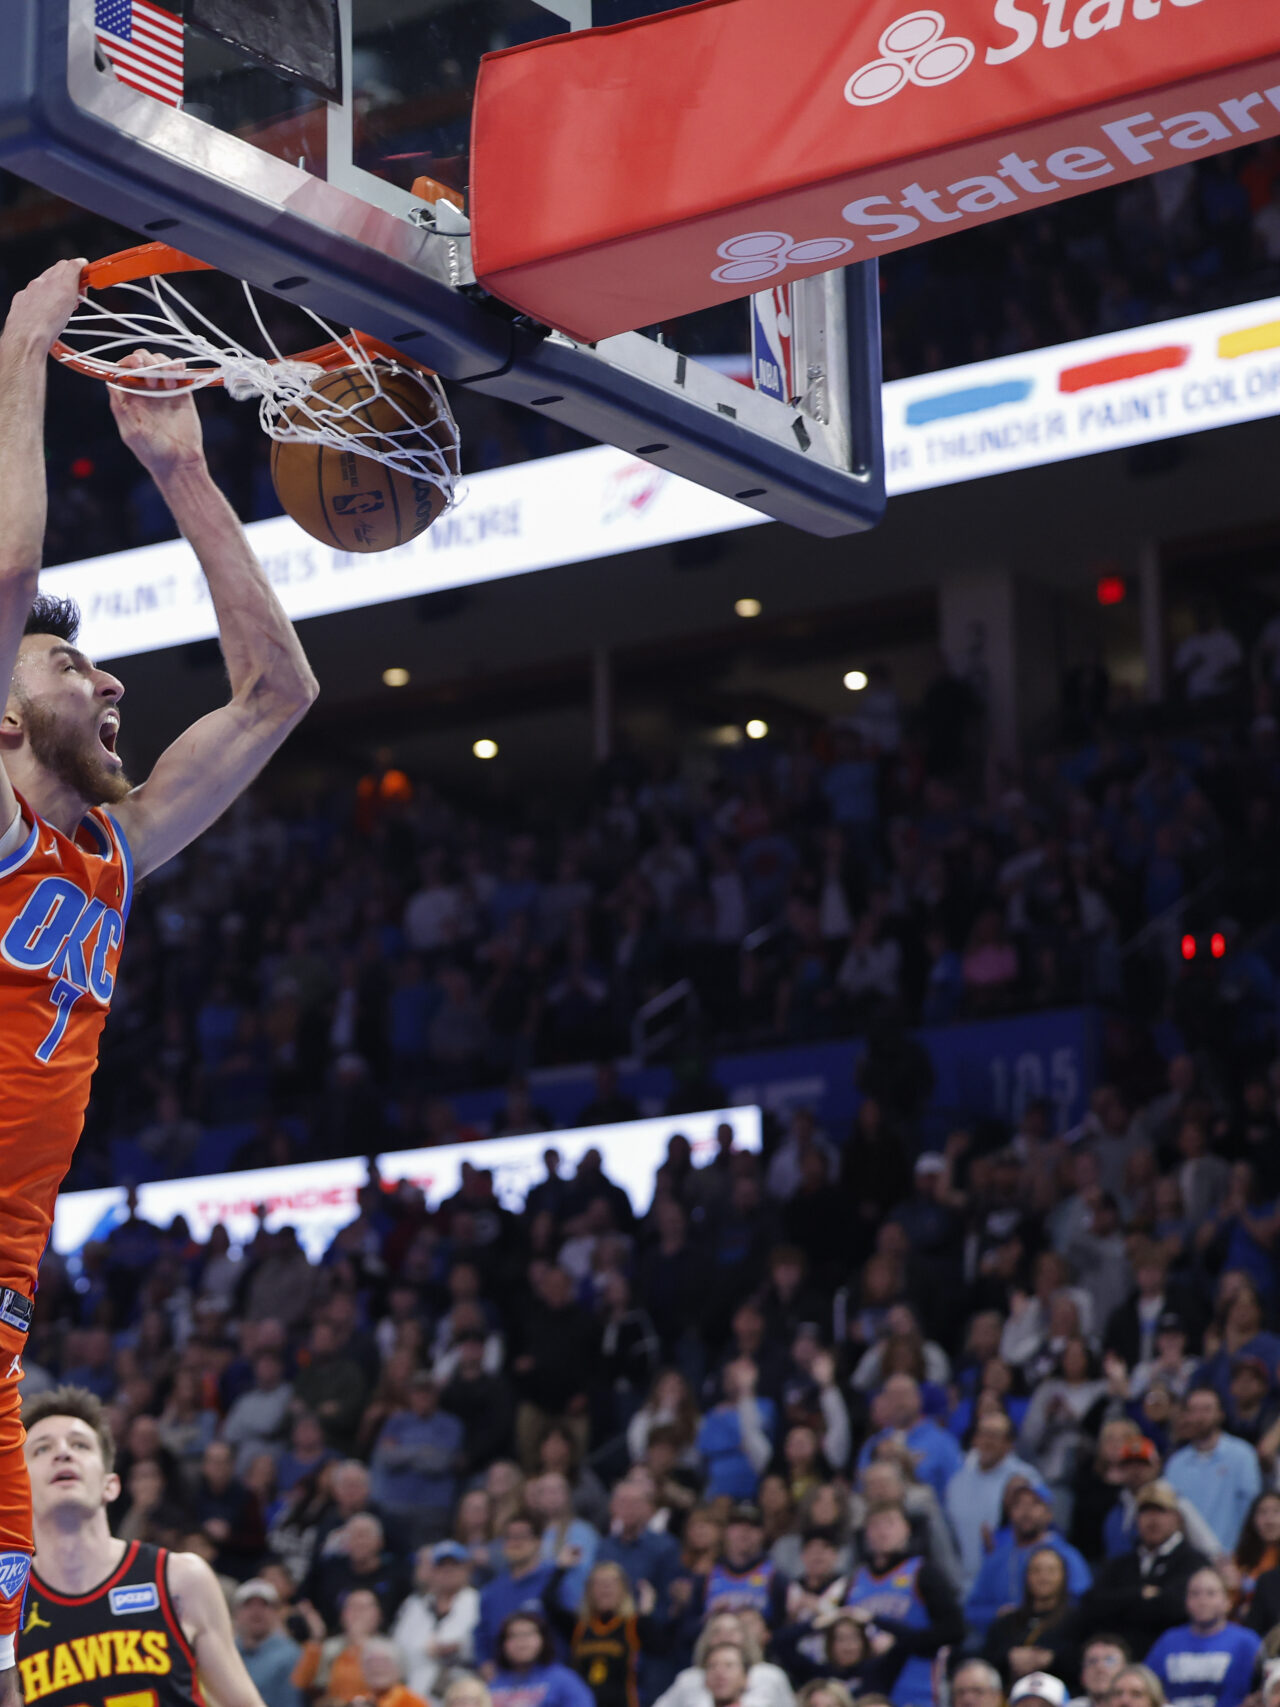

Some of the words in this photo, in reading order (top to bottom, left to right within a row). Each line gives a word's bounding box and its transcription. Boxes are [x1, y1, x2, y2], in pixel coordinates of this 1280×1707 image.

[758, 358, 780, 393] NBA
[0, 876, 123, 1004] OKC
[34, 977, 85, 1063] 7
[19, 1629, 173, 1705] HAWKS
